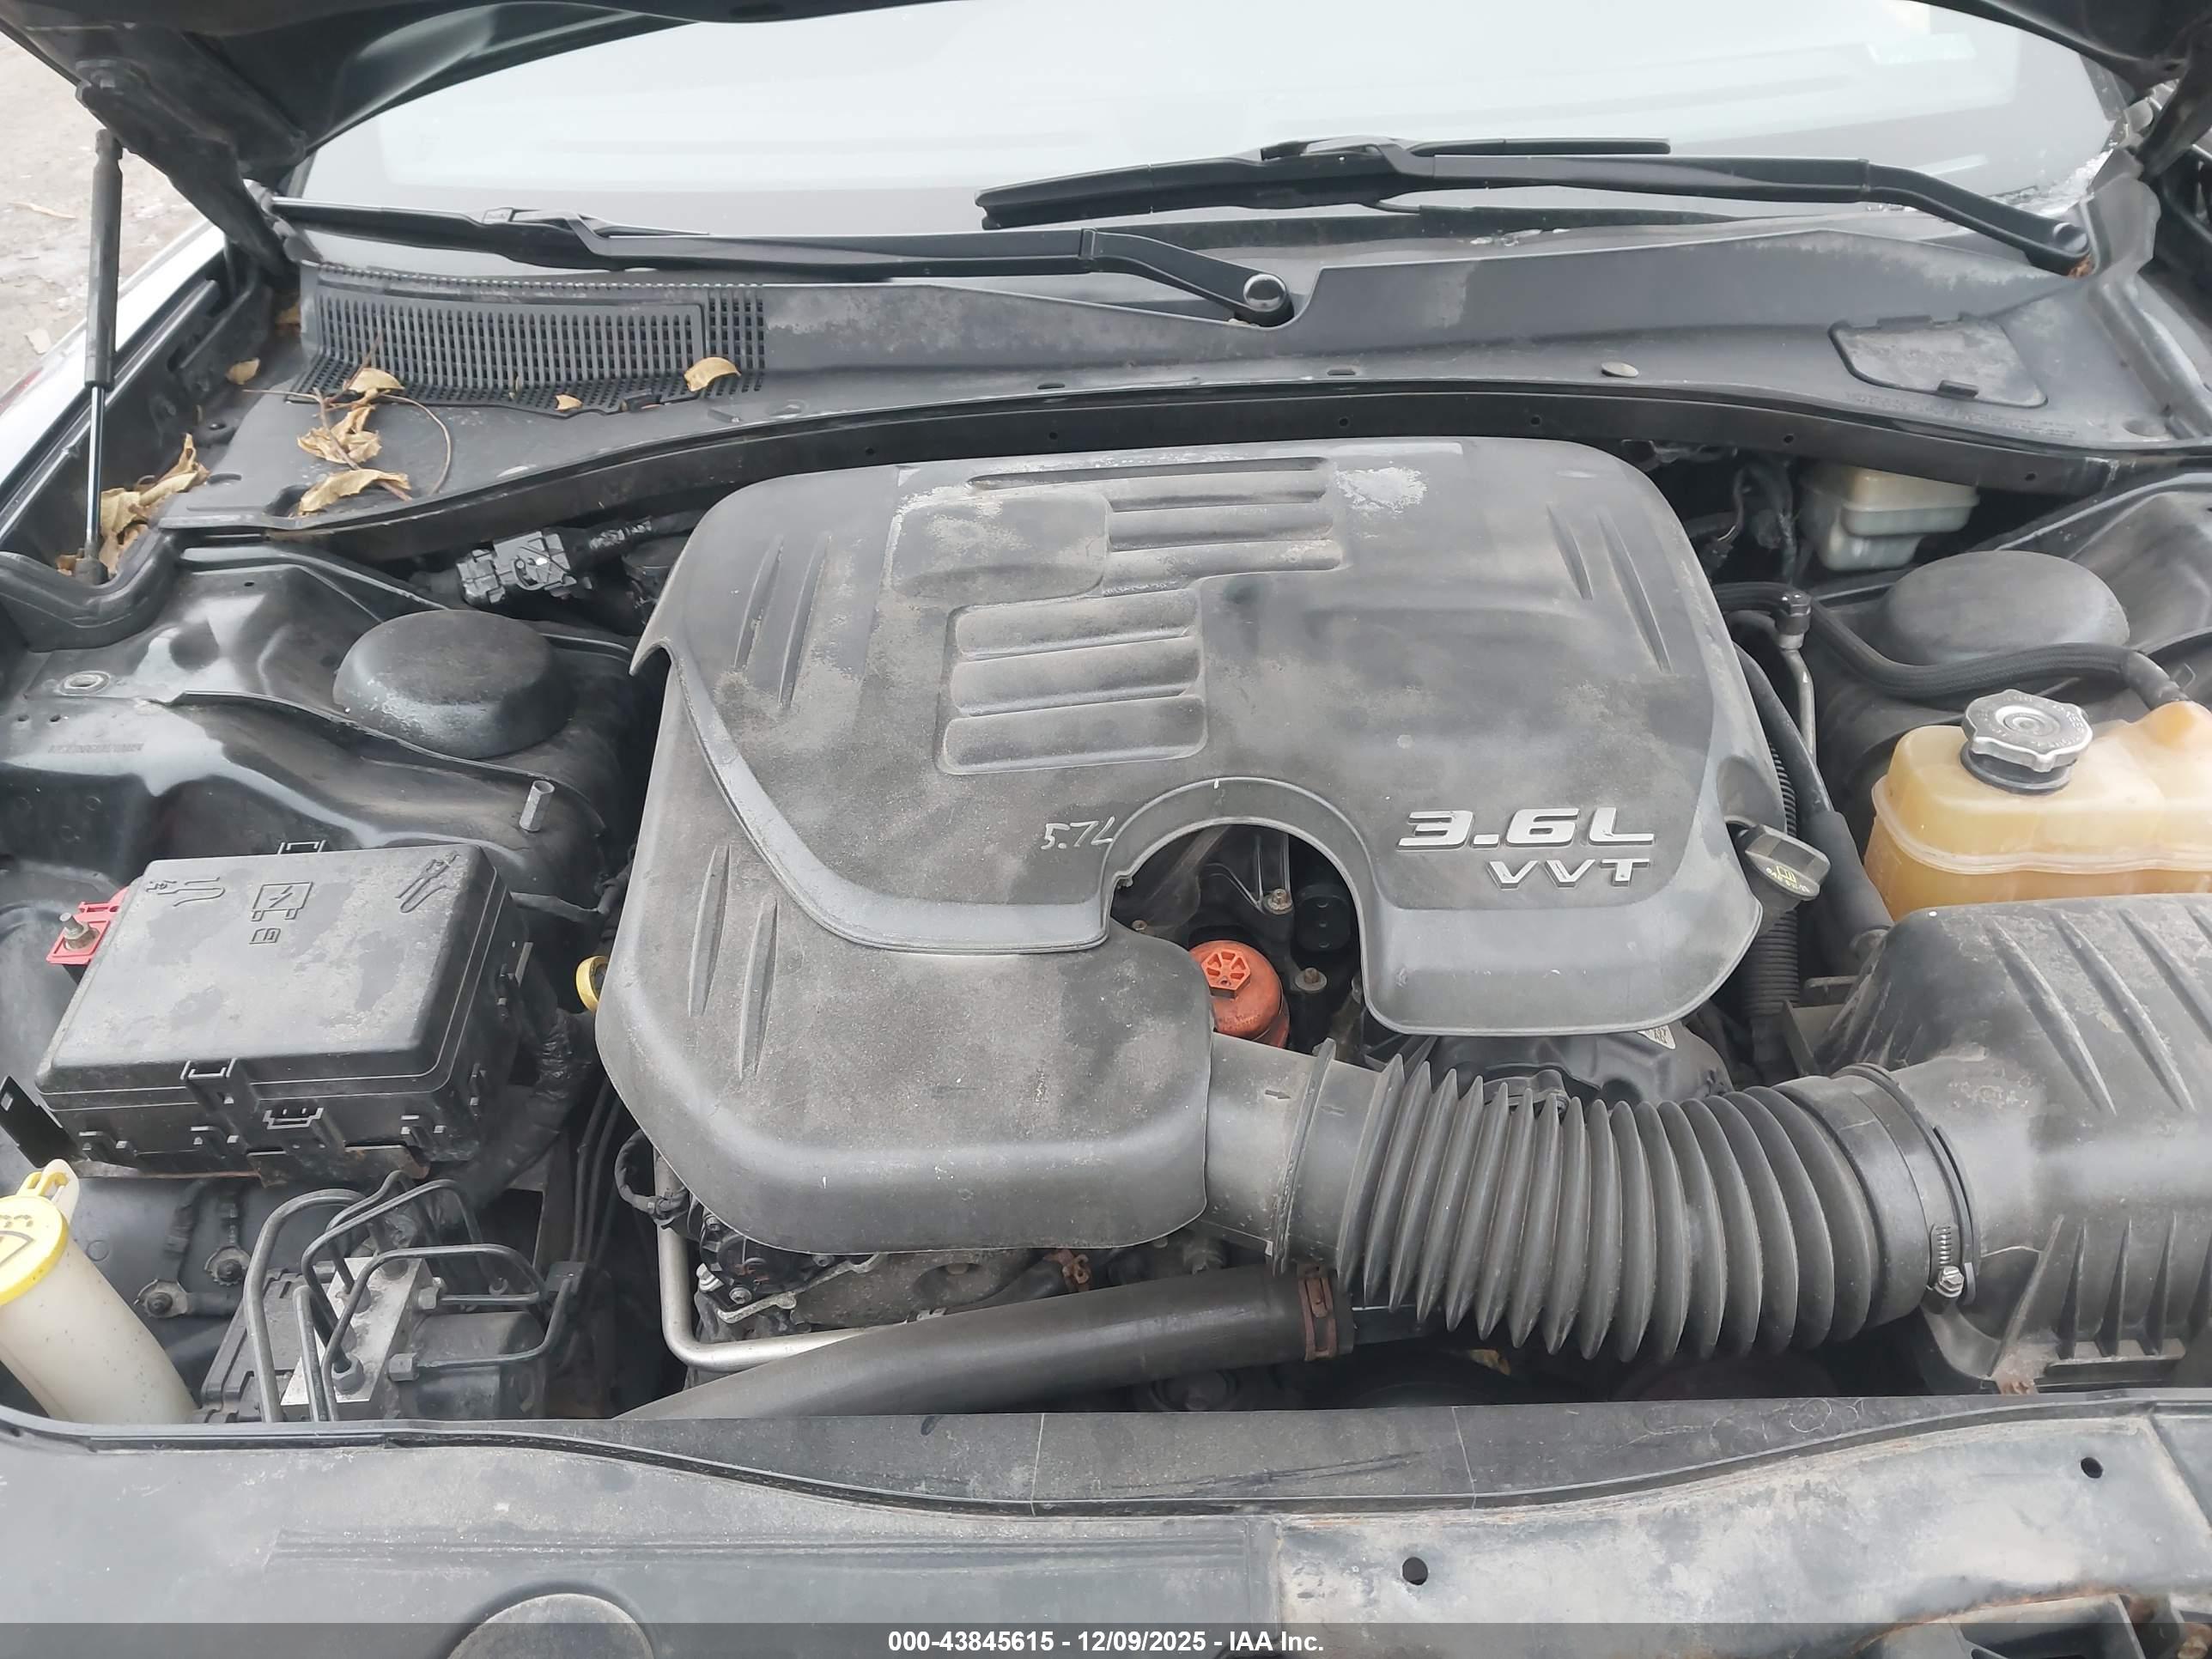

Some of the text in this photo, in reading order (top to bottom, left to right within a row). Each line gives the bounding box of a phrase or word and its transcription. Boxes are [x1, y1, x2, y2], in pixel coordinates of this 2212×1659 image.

[1040, 816, 1115, 850] 5.7L
[1396, 807, 1656, 851] 3.6L
[1486, 858, 1650, 890] VVT
